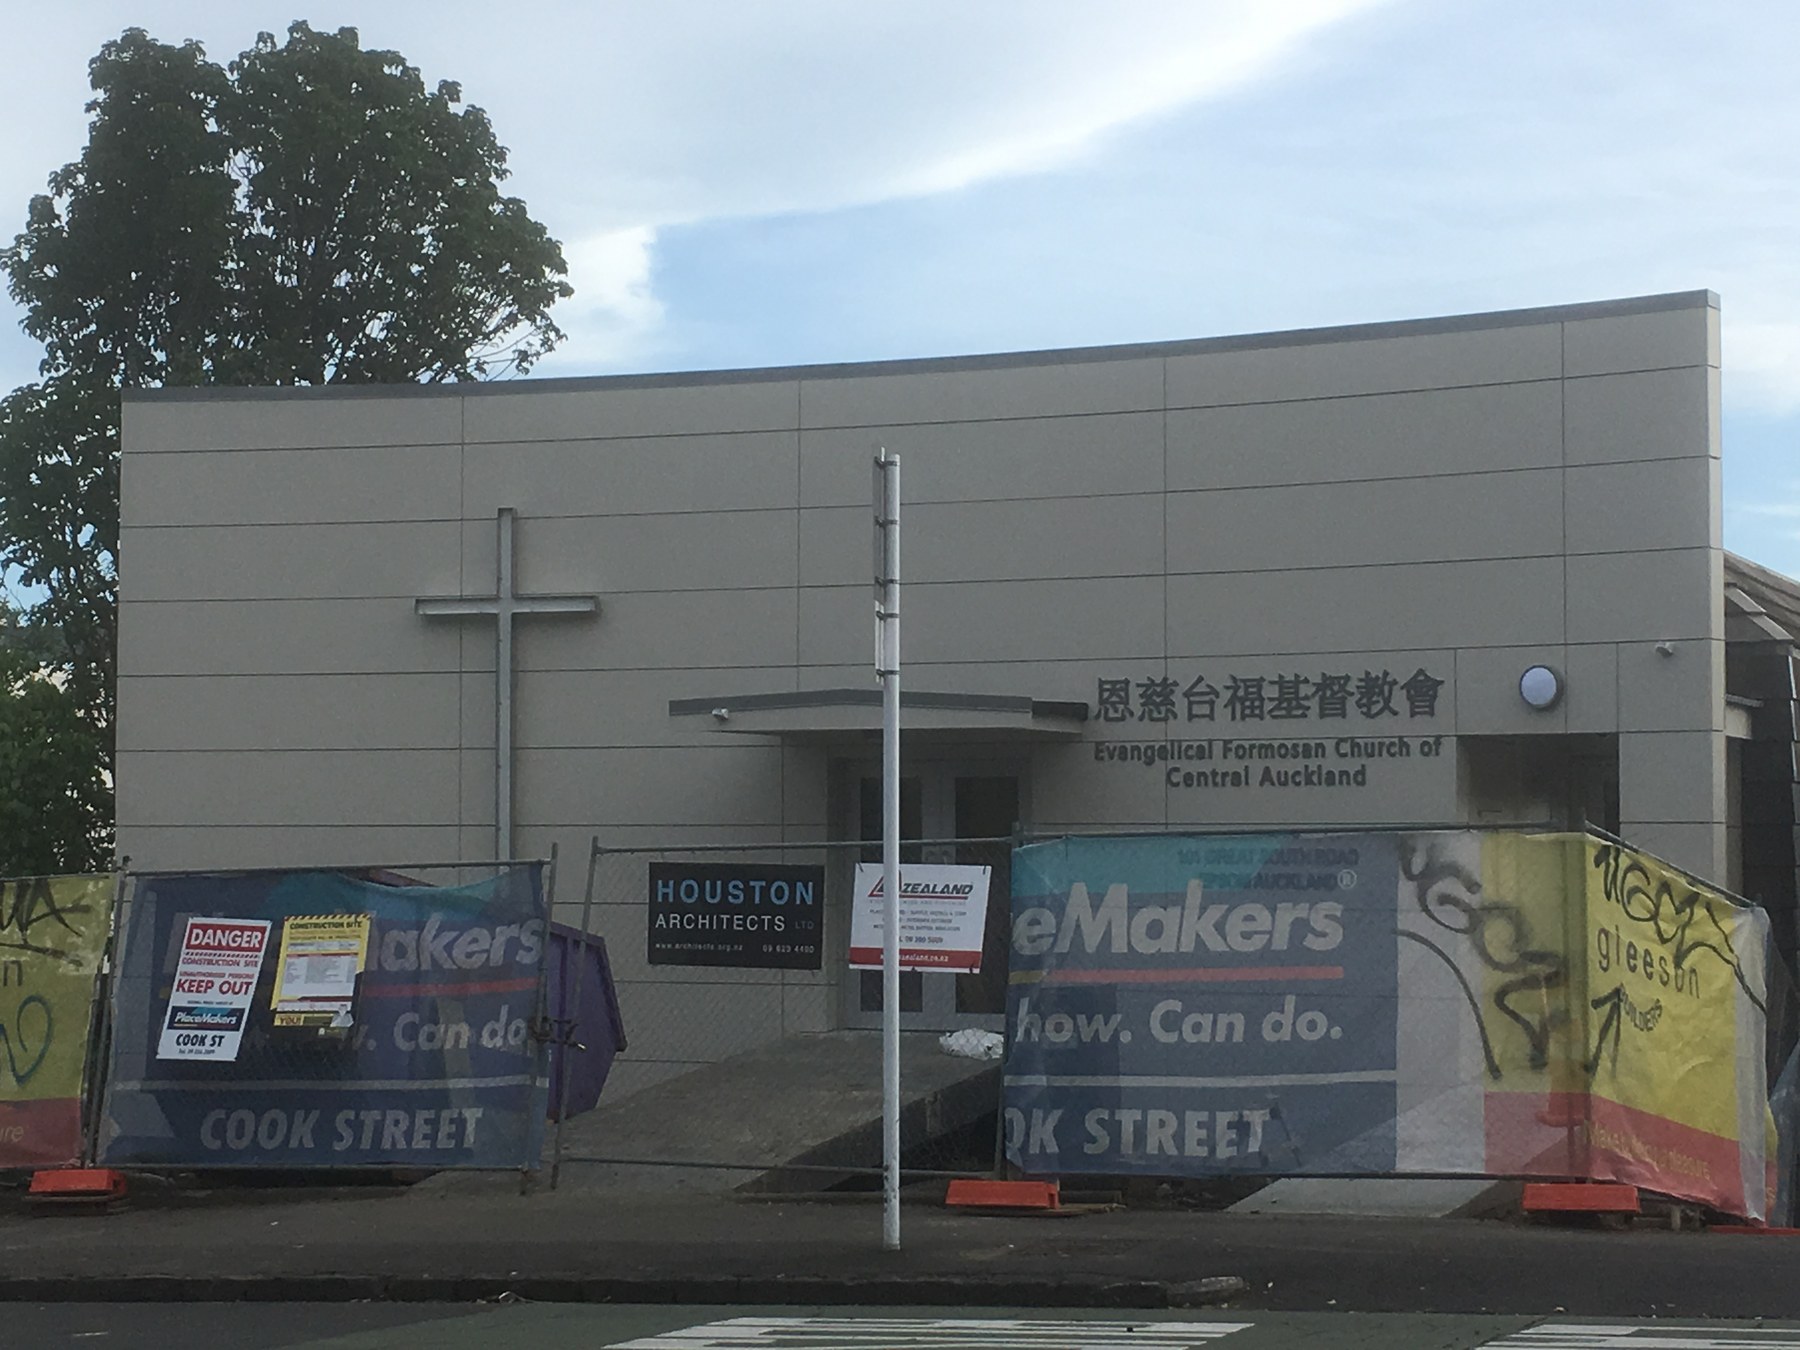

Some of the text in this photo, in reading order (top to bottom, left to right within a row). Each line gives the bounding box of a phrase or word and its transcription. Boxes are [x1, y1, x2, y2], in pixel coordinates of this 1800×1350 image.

[1094, 668, 1445, 723] 恩慈台福基督教會
[1094, 735, 1443, 766] Evangelical Formosan Church of
[1166, 764, 1367, 788] Central Auckland
[657, 879, 814, 906] HOUSTON
[289, 921, 344, 930] CONSTRUCTION
[655, 913, 815, 932] ARCHITECTS LTD
[189, 928, 262, 949] DANGER
[366, 912, 545, 971] akers
[182, 956, 258, 968] CONSTRUCTION SITE
[175, 978, 254, 995] KEEP OUT
[174, 1011, 238, 1025] PlaceMakers
[394, 1011, 470, 1050] Can
[1015, 995, 1344, 1043] how. Can do.
[175, 1033, 226, 1048] COOK ST
[200, 1107, 485, 1151] COOK STREET
[1083, 1108, 1271, 1159] STREET
